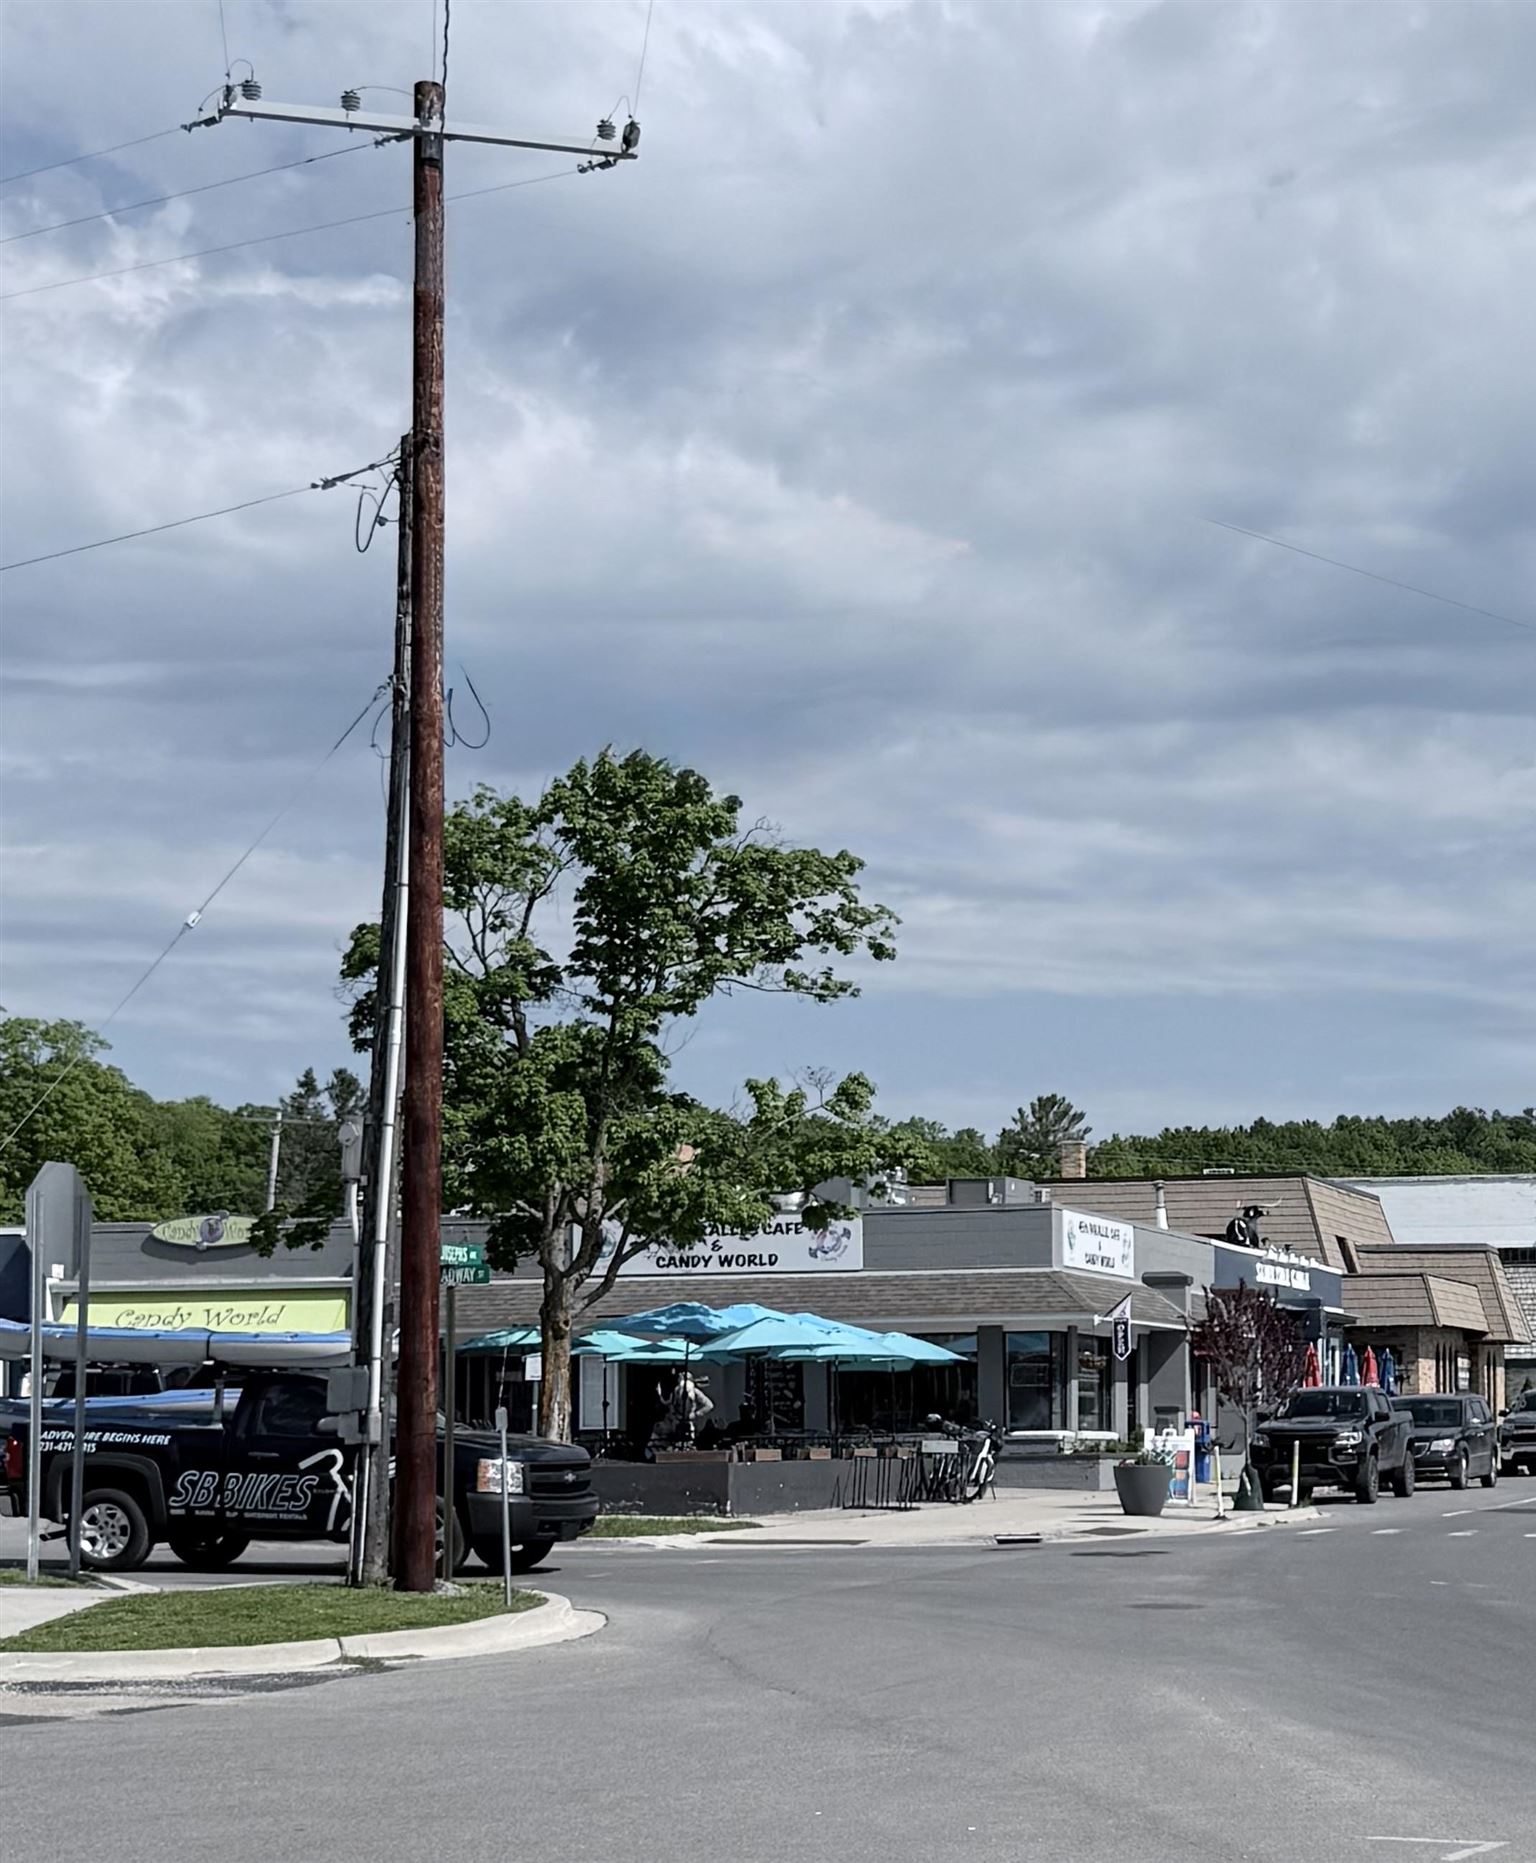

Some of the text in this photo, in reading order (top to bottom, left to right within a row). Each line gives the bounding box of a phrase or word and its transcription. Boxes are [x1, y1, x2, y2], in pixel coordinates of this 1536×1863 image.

[762, 1221, 804, 1236] CAFE
[710, 1240, 724, 1252] &
[655, 1253, 779, 1269] CANDY WORLD
[440, 1267, 476, 1283] ADWAY
[114, 1304, 287, 1329] Candy World
[40, 1430, 172, 1446] ADVENURE BEGINS HERE
[168, 1469, 320, 1512] SB BIKES
